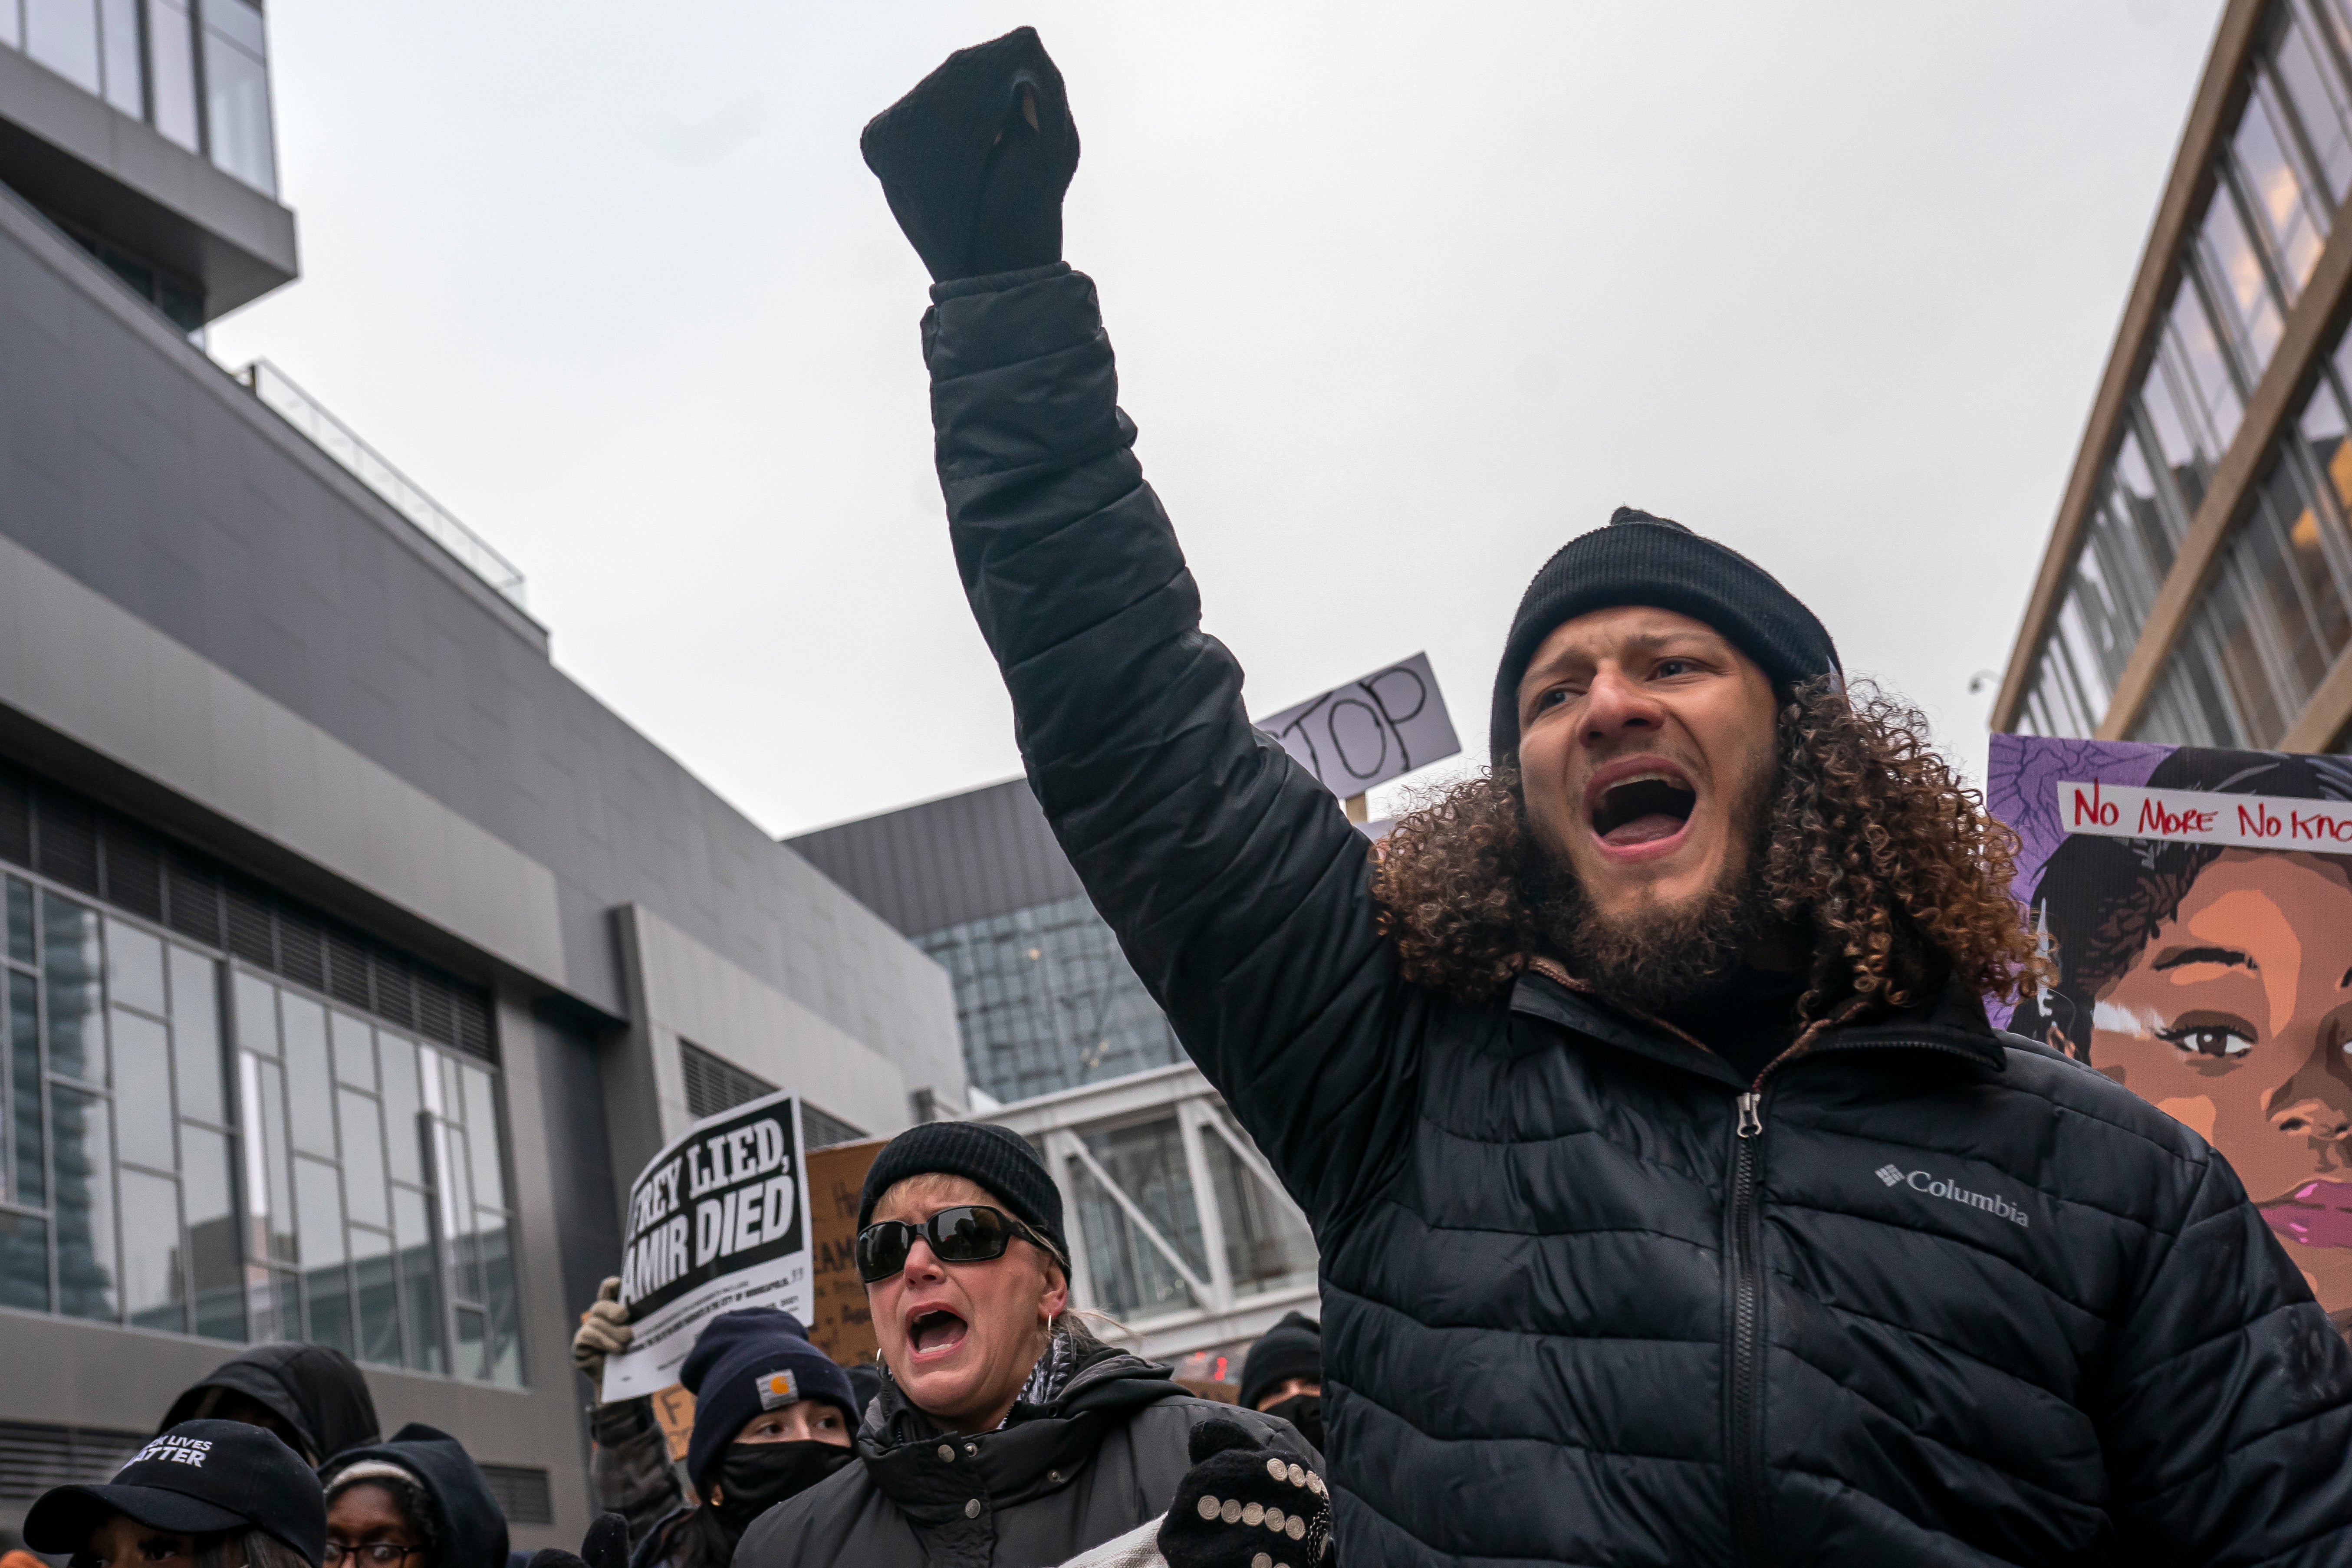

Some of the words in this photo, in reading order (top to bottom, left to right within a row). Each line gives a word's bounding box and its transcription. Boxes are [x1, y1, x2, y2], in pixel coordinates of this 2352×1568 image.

[1263, 666, 1428, 782] TOP
[2075, 776, 2119, 827] No
[2237, 802, 2282, 838] No
[687, 1118, 790, 1199] LIED,
[1907, 1170, 2029, 1228] Columbia
[622, 1214, 689, 1305] AMIR
[695, 1174, 795, 1268] DIED
[167, 1435, 213, 1451] LIVES
